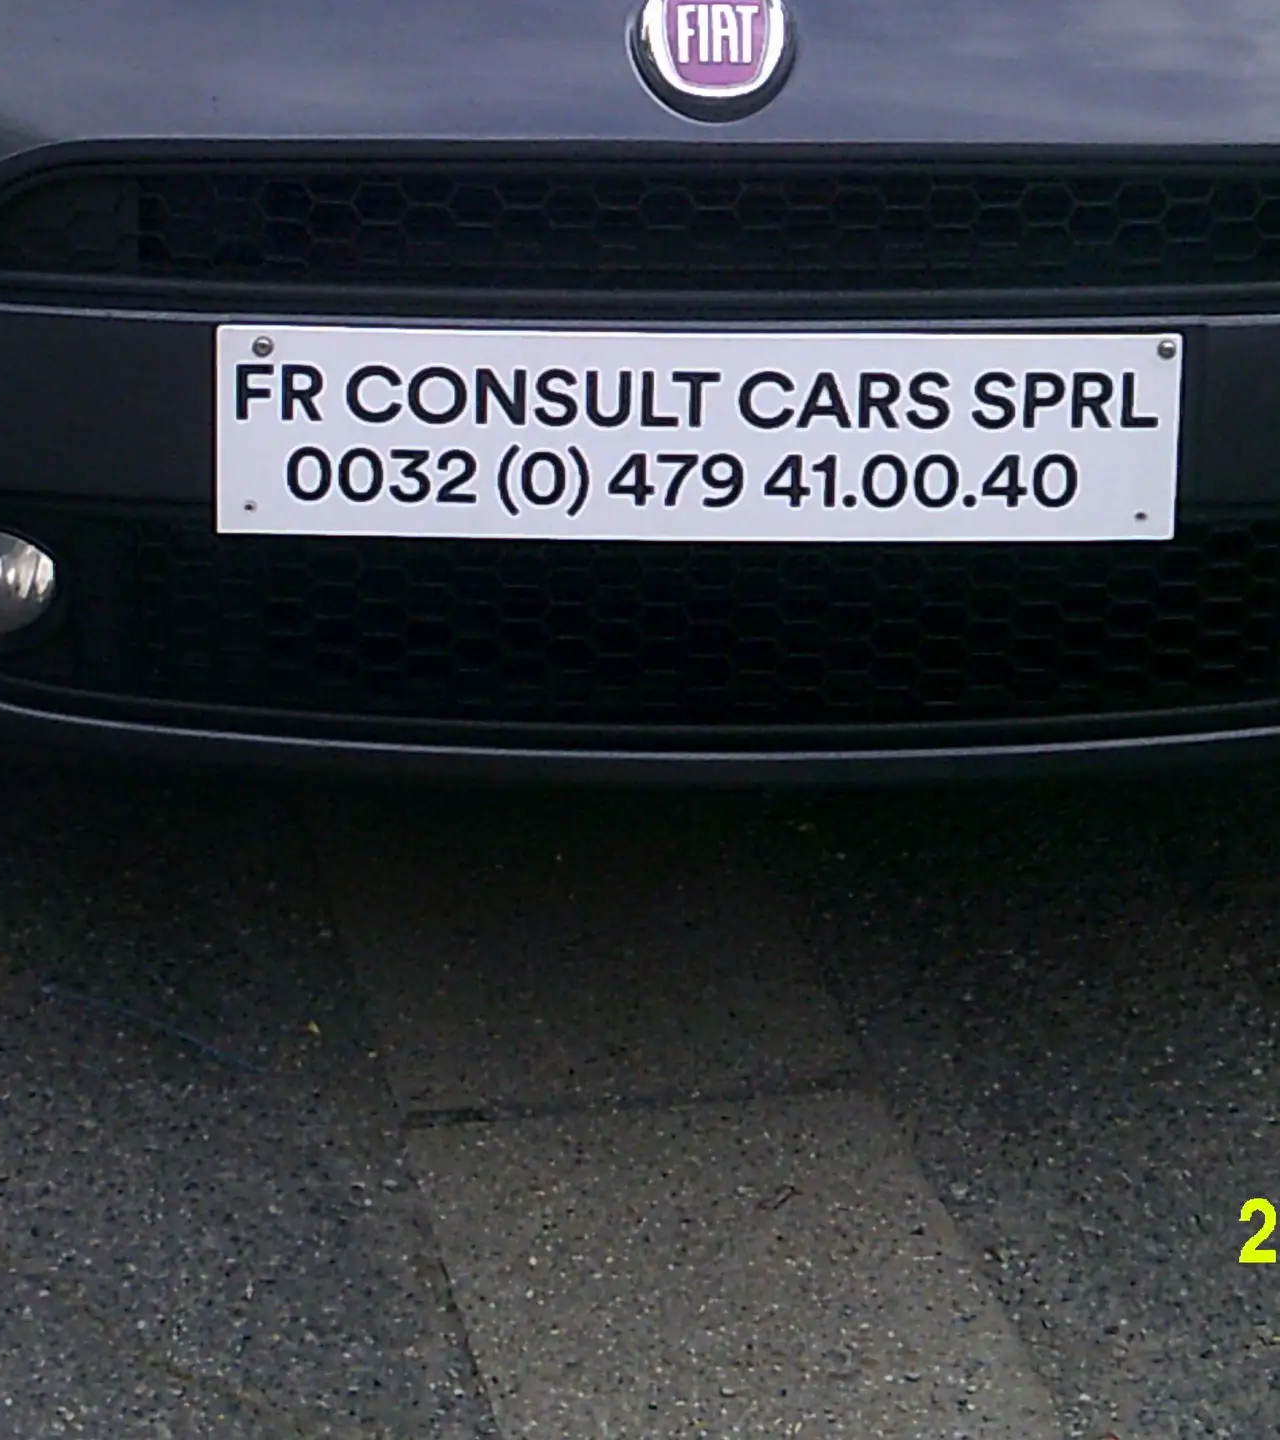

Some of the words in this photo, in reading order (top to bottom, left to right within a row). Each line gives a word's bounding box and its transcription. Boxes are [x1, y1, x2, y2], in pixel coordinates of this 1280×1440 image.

[676, 3, 759, 64] FIAT
[235, 364, 323, 421] FR
[346, 365, 721, 428] CONSULT
[738, 371, 950, 430] CARS
[971, 371, 1159, 430] SPRL
[286, 446, 477, 504] 0032
[497, 444, 590, 517] (0)
[608, 453, 744, 508] 479
[764, 453, 1078, 508] 41.00.40
